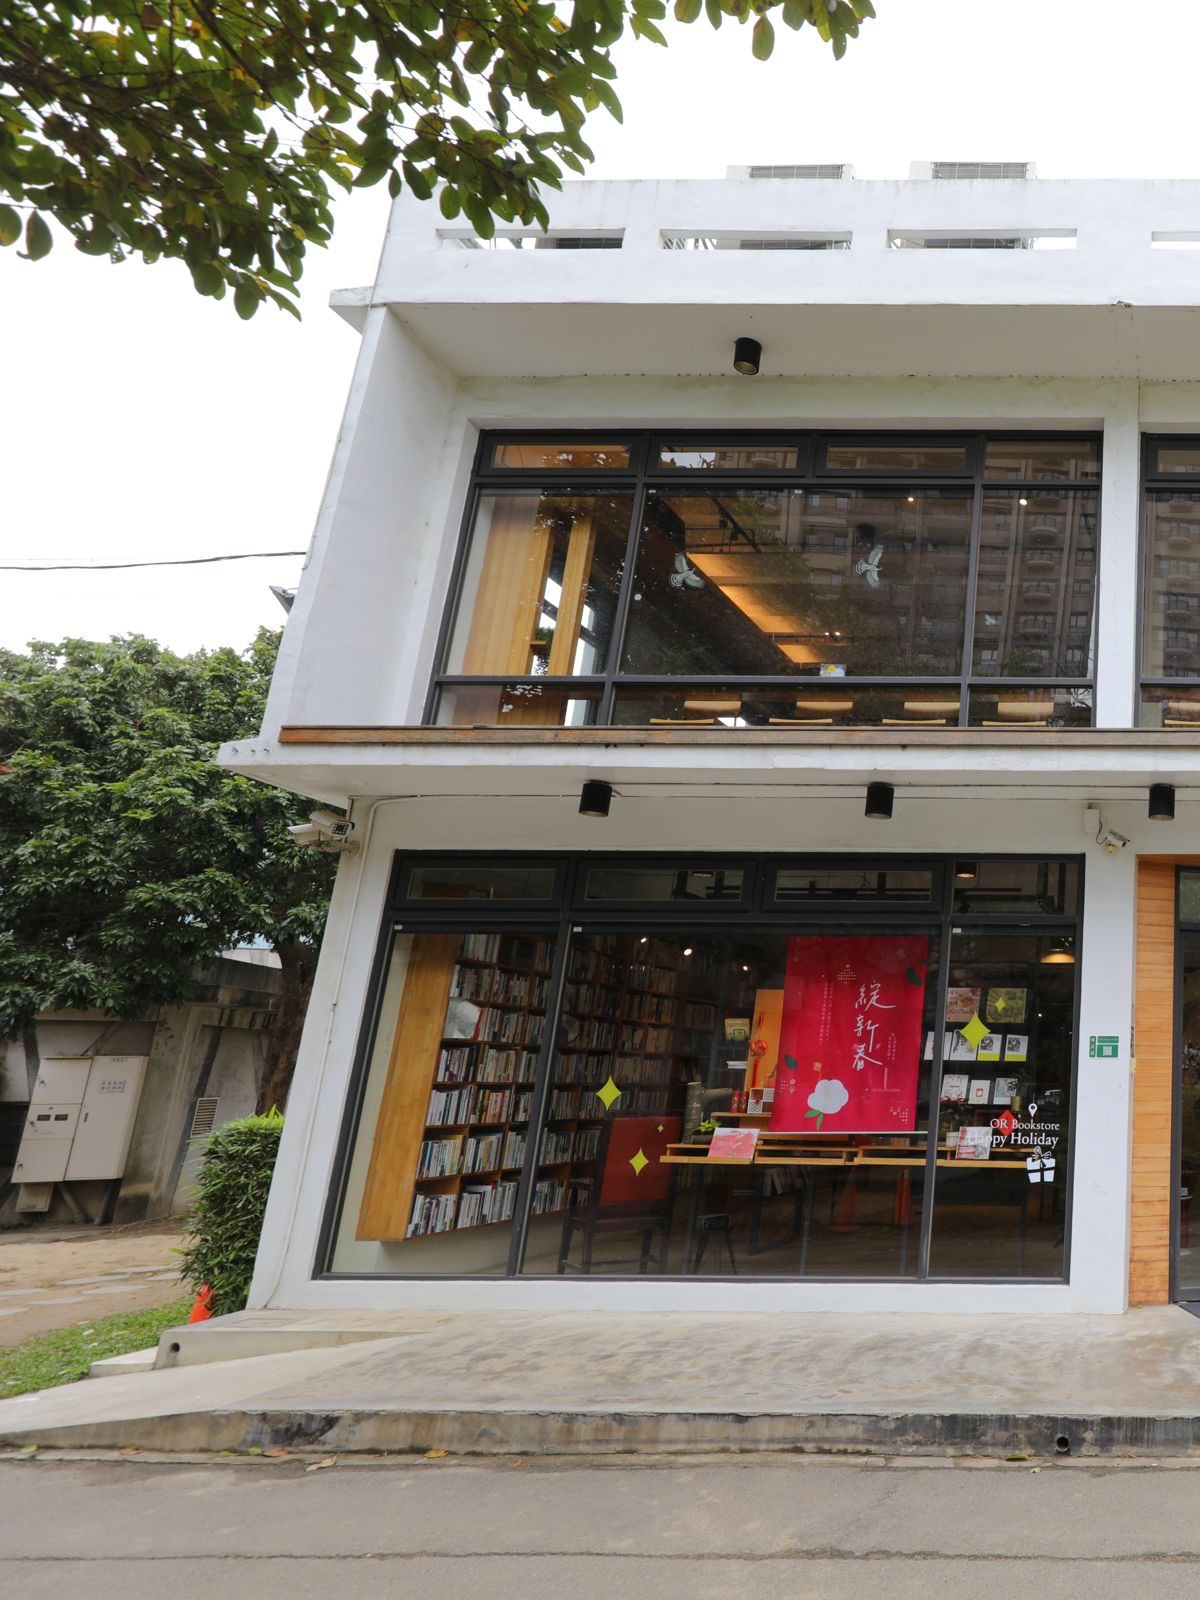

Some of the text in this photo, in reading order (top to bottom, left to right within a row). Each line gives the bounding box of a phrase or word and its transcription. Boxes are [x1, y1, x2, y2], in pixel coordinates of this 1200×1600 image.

[852, 979, 897, 1072] 綻新春
[990, 1118, 1060, 1130] OR Bookstore
[1010, 1132, 1059, 1149] Holiday
